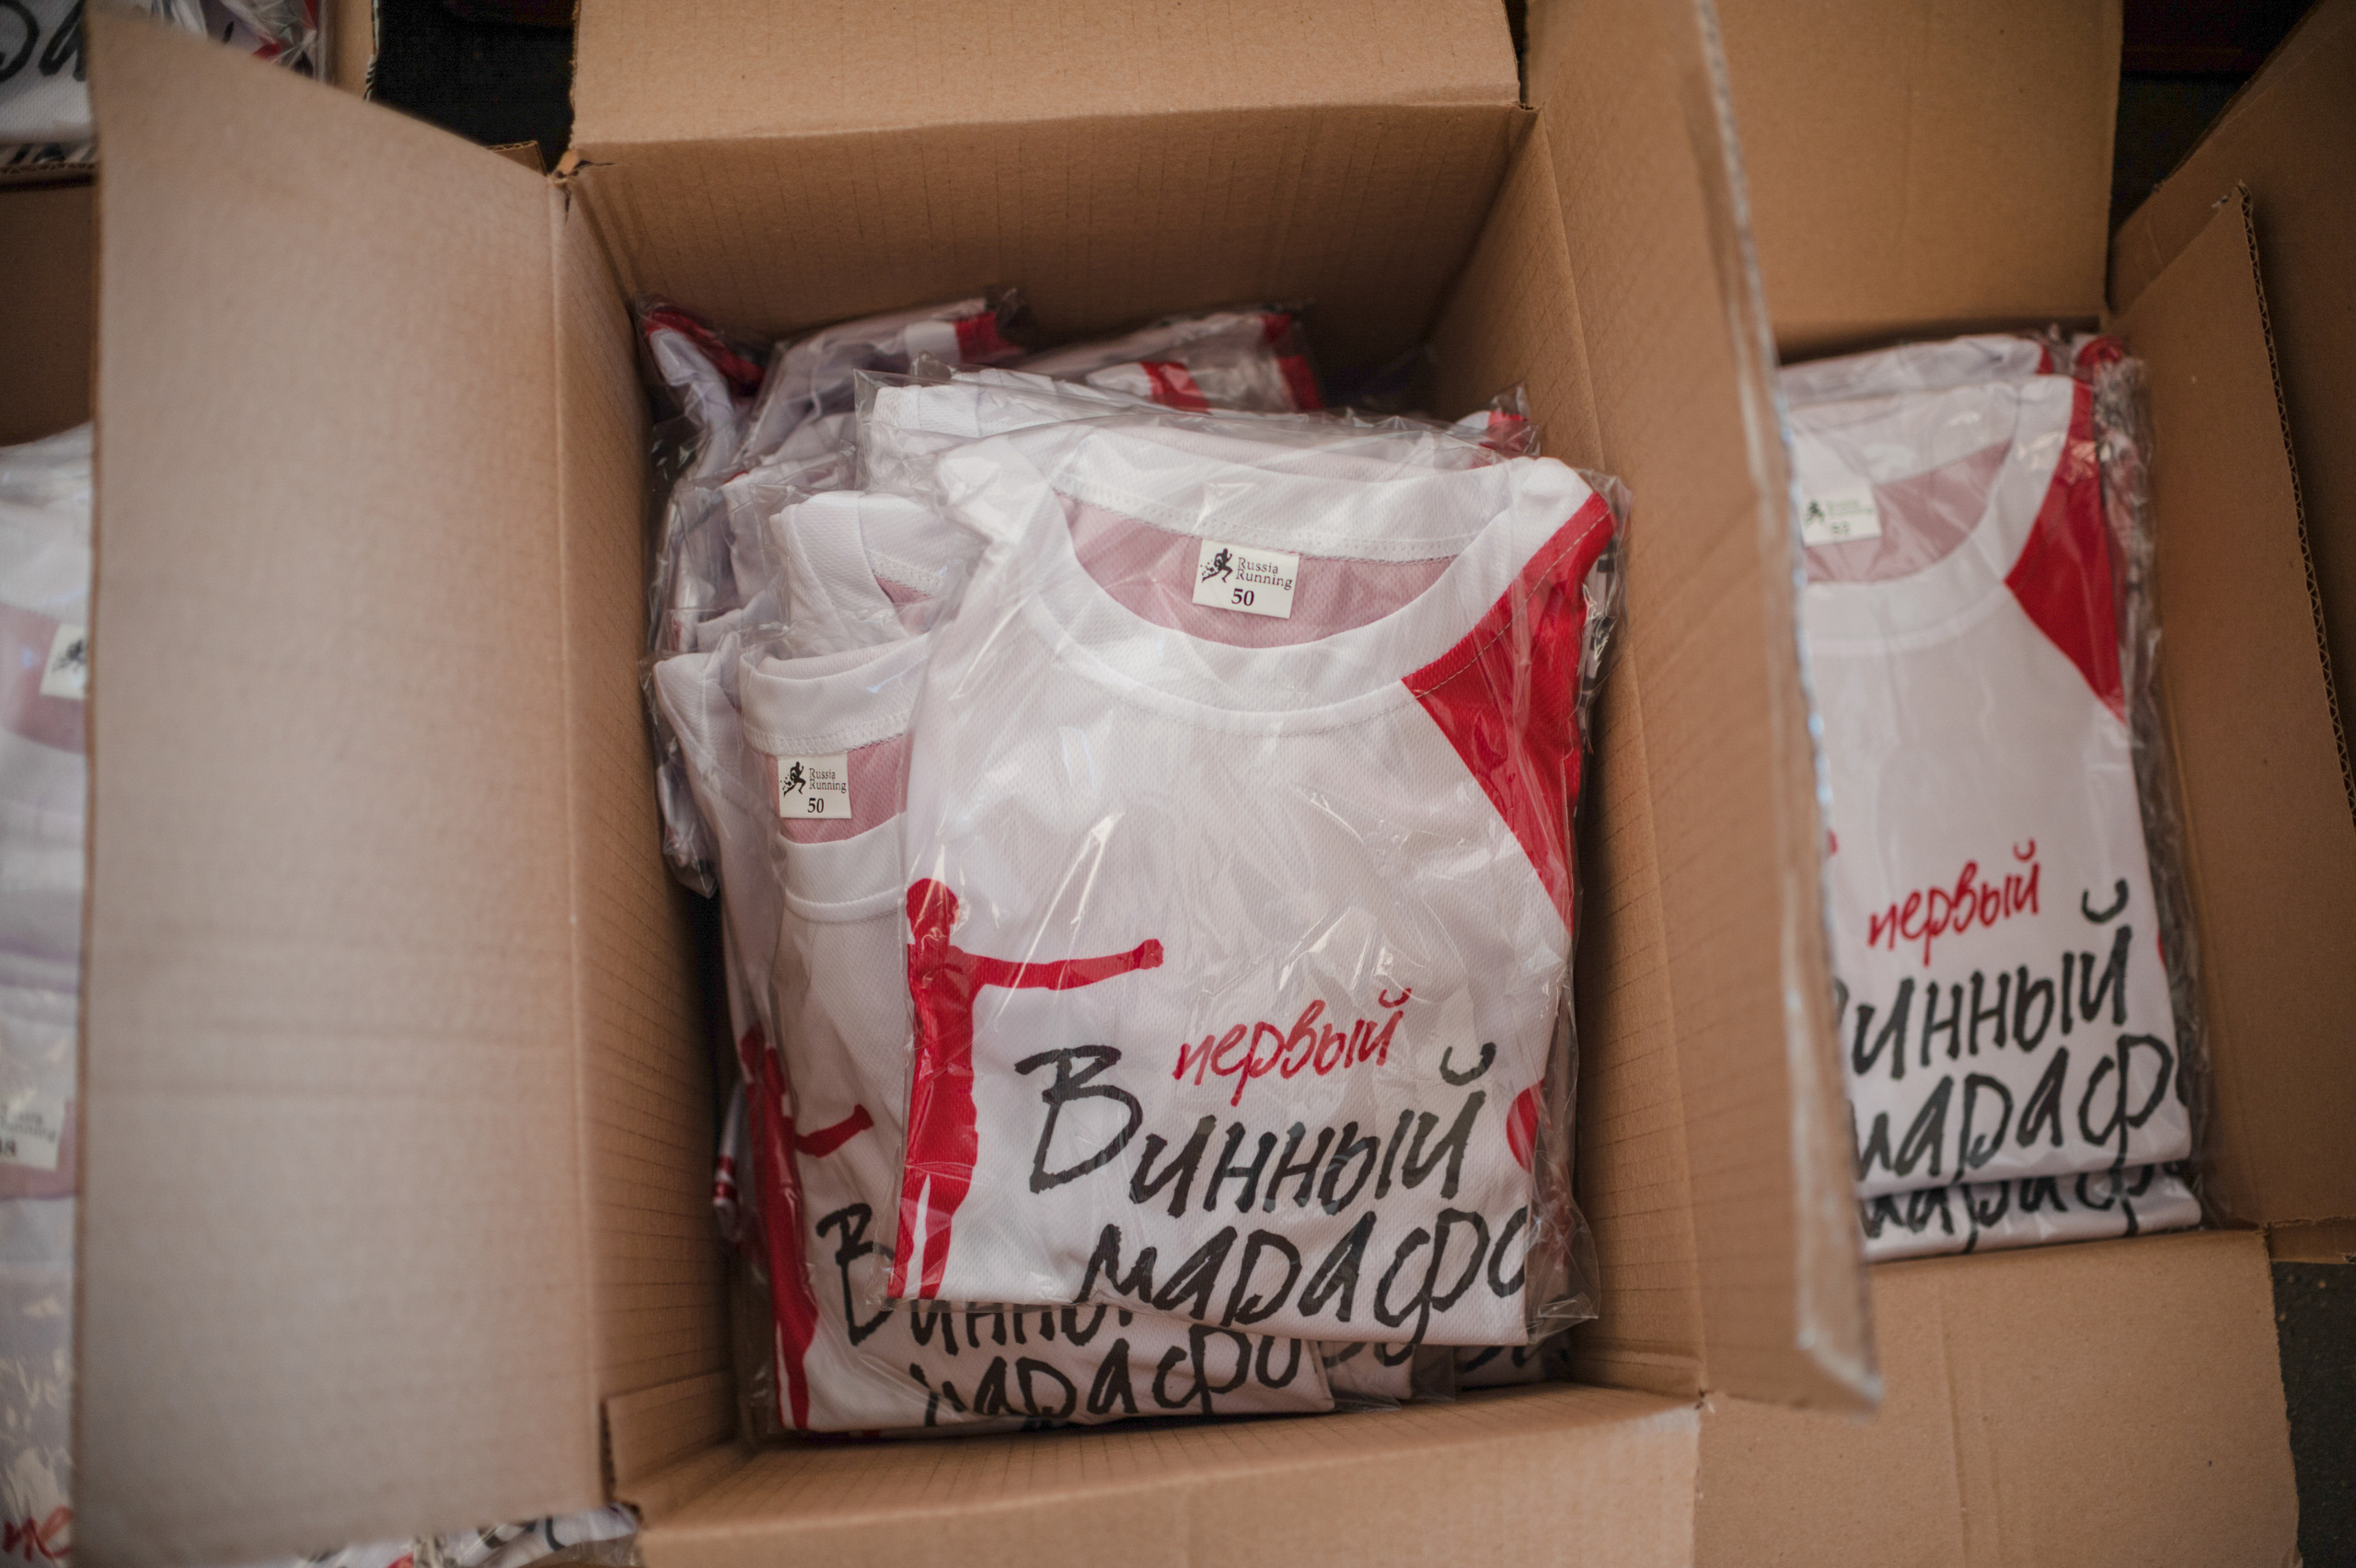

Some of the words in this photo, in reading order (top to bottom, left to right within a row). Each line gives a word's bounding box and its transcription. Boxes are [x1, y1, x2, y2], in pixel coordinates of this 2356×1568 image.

[1238, 557, 1278, 574] Russia
[1235, 569, 1293, 591] Running
[1231, 588, 1254, 606] 50
[809, 767, 836, 779] Russia
[809, 778, 847, 793] Running
[807, 797, 824, 813] 50
[1868, 838, 2040, 967] первый
[1833, 879, 2131, 1078] инный
[1172, 987, 1411, 1106] первый
[1014, 1042, 1496, 1217] Винный
